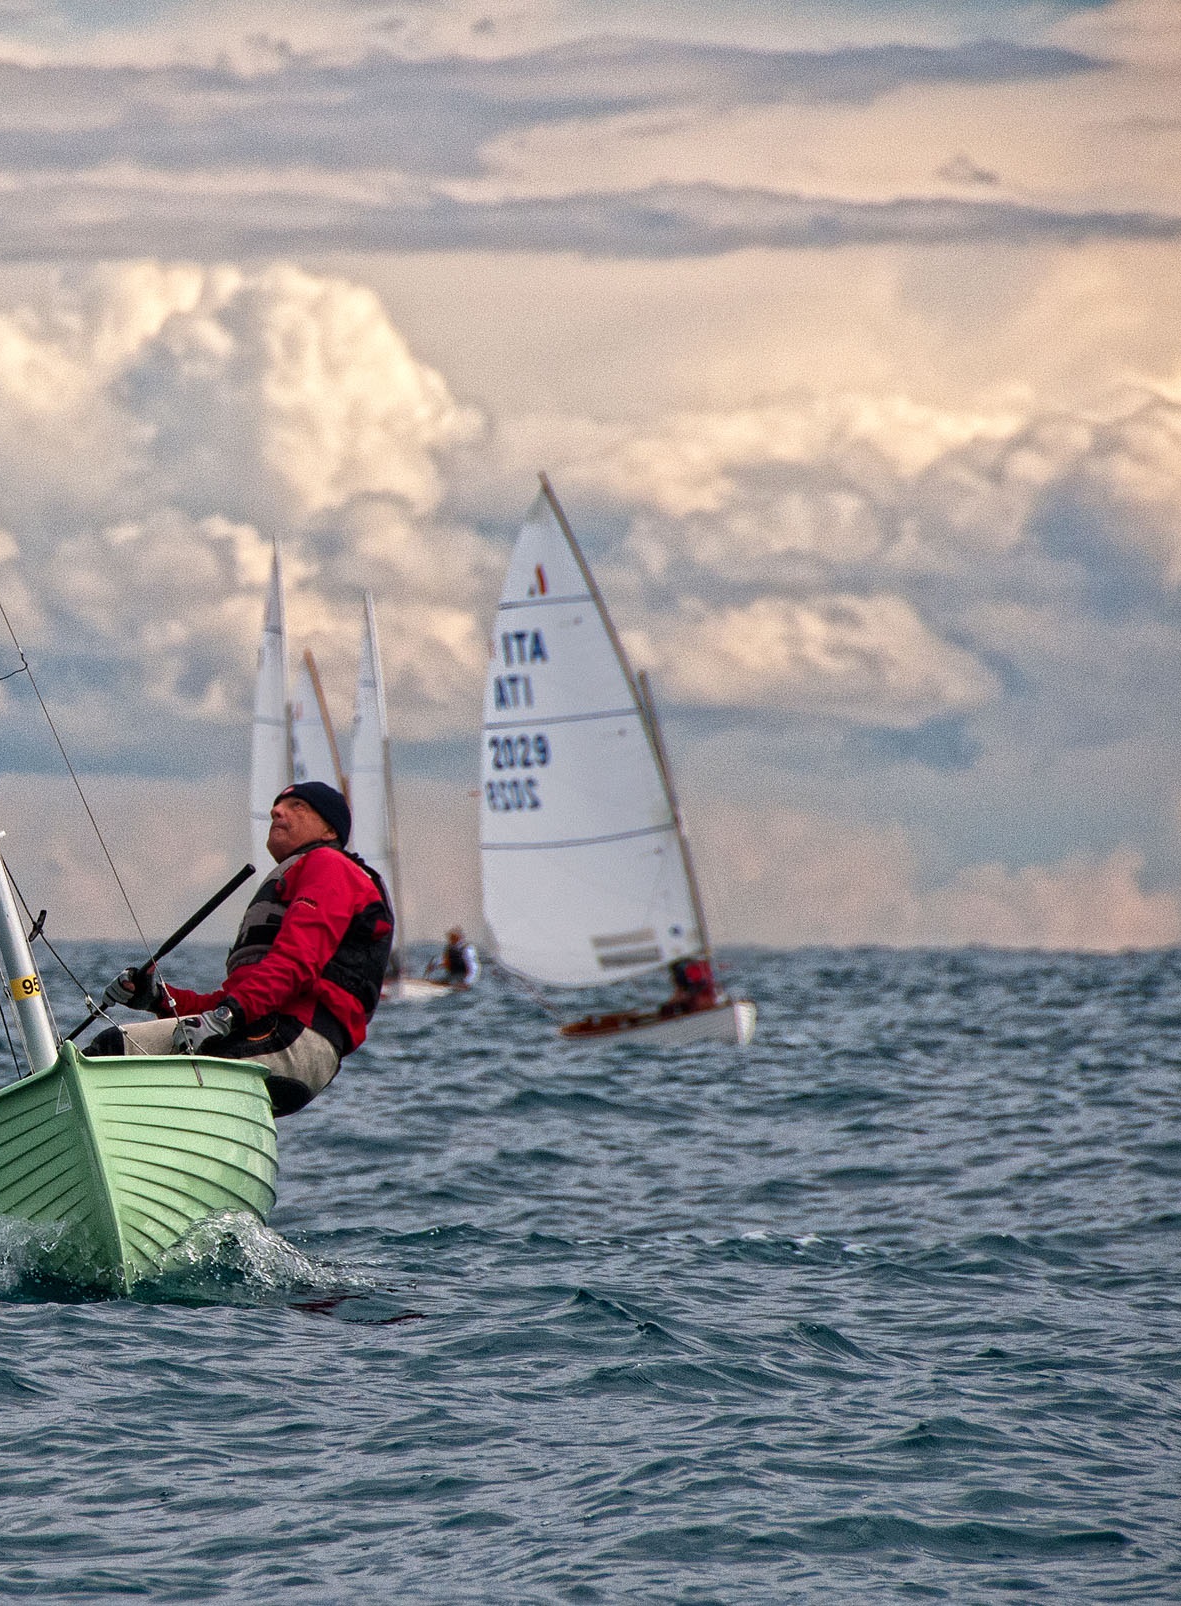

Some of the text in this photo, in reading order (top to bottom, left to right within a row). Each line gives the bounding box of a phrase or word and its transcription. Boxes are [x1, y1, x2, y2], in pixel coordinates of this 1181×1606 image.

[503, 629, 548, 667] ITA
[489, 734, 550, 770] 2029
[22, 977, 40, 995] 95
